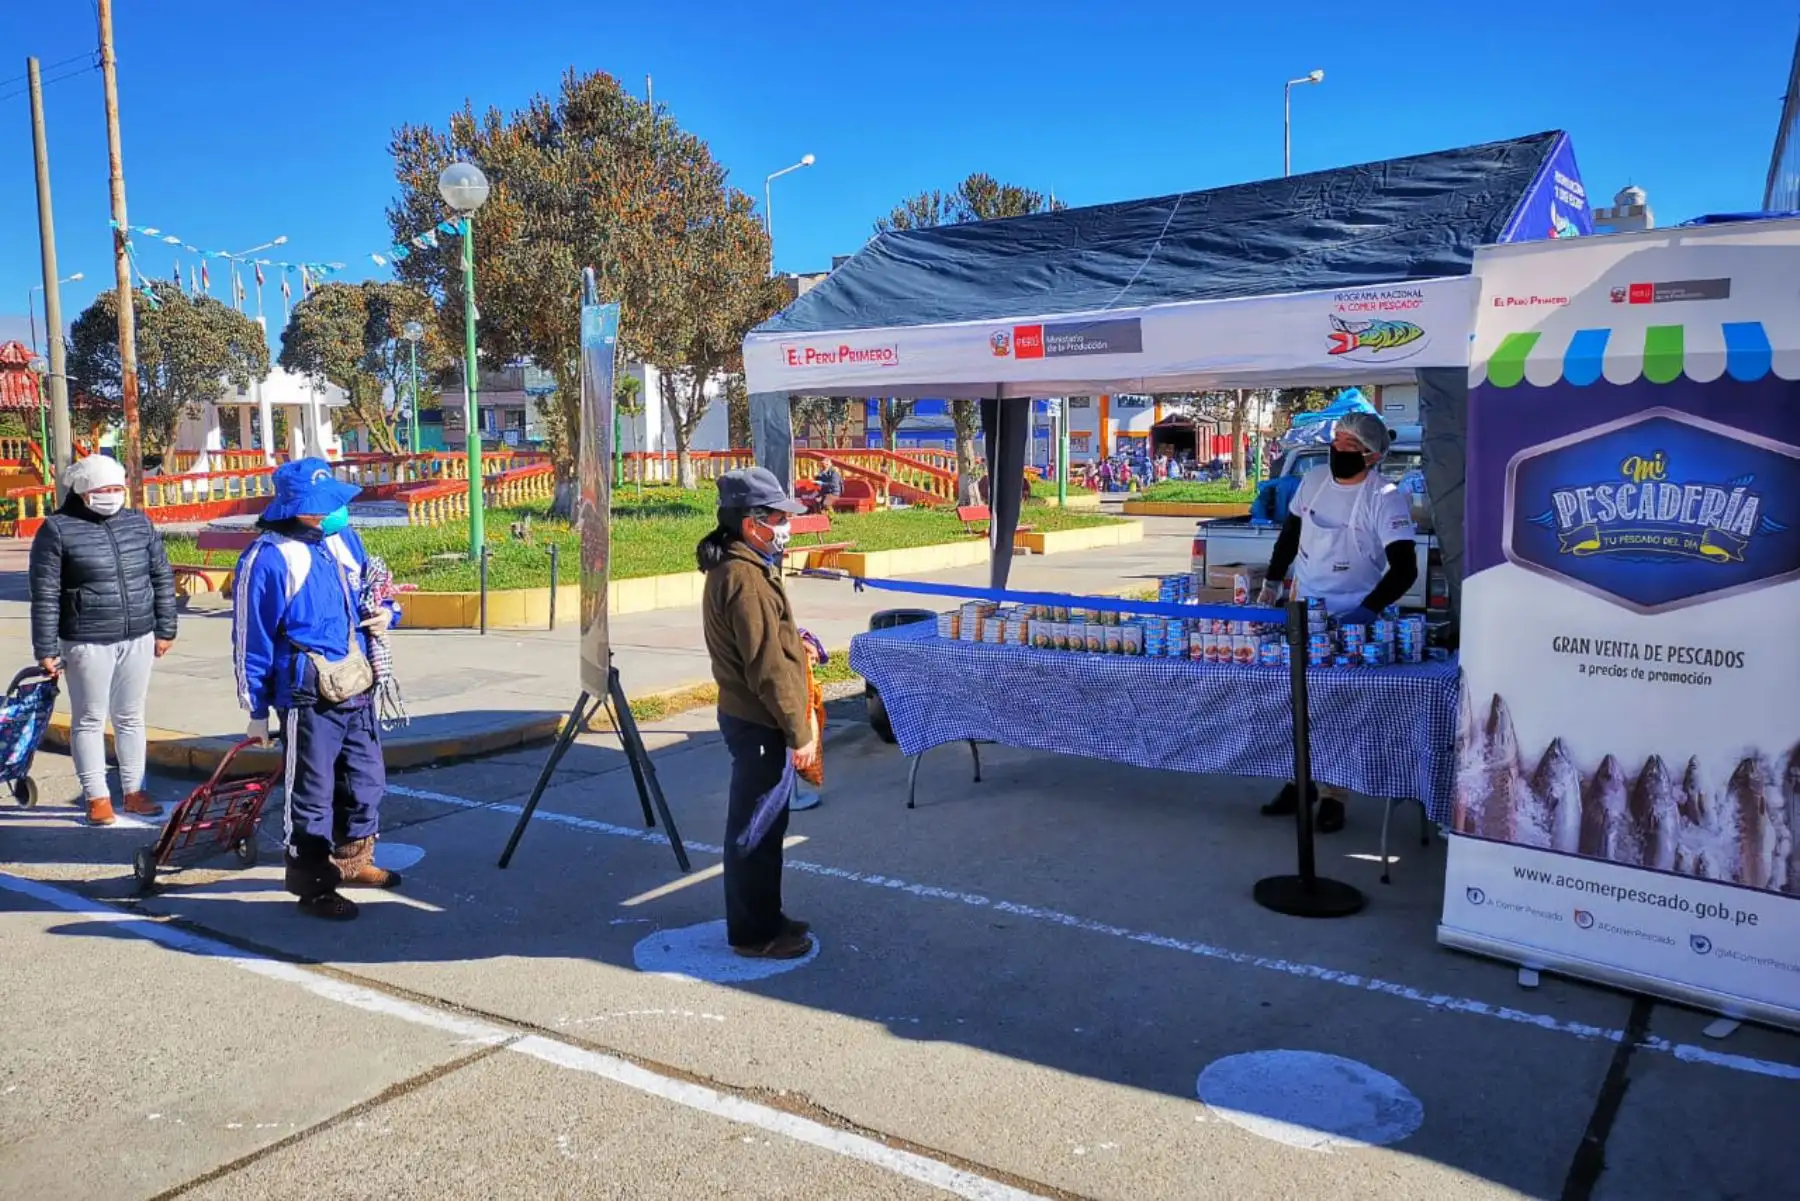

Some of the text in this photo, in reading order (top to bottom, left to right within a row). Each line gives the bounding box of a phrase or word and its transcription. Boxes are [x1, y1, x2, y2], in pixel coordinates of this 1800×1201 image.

[1552, 482, 1760, 536] PESCADERÍA
[1619, 534, 1660, 544] PESCADO
[1663, 536, 1680, 546] DEL
[1553, 636, 1745, 669] GRAN VENTA DE PESCADOS
[1579, 663, 1712, 686] a precios de promoción
[1513, 865, 1759, 927] www.acomerpescado.gob.pe
